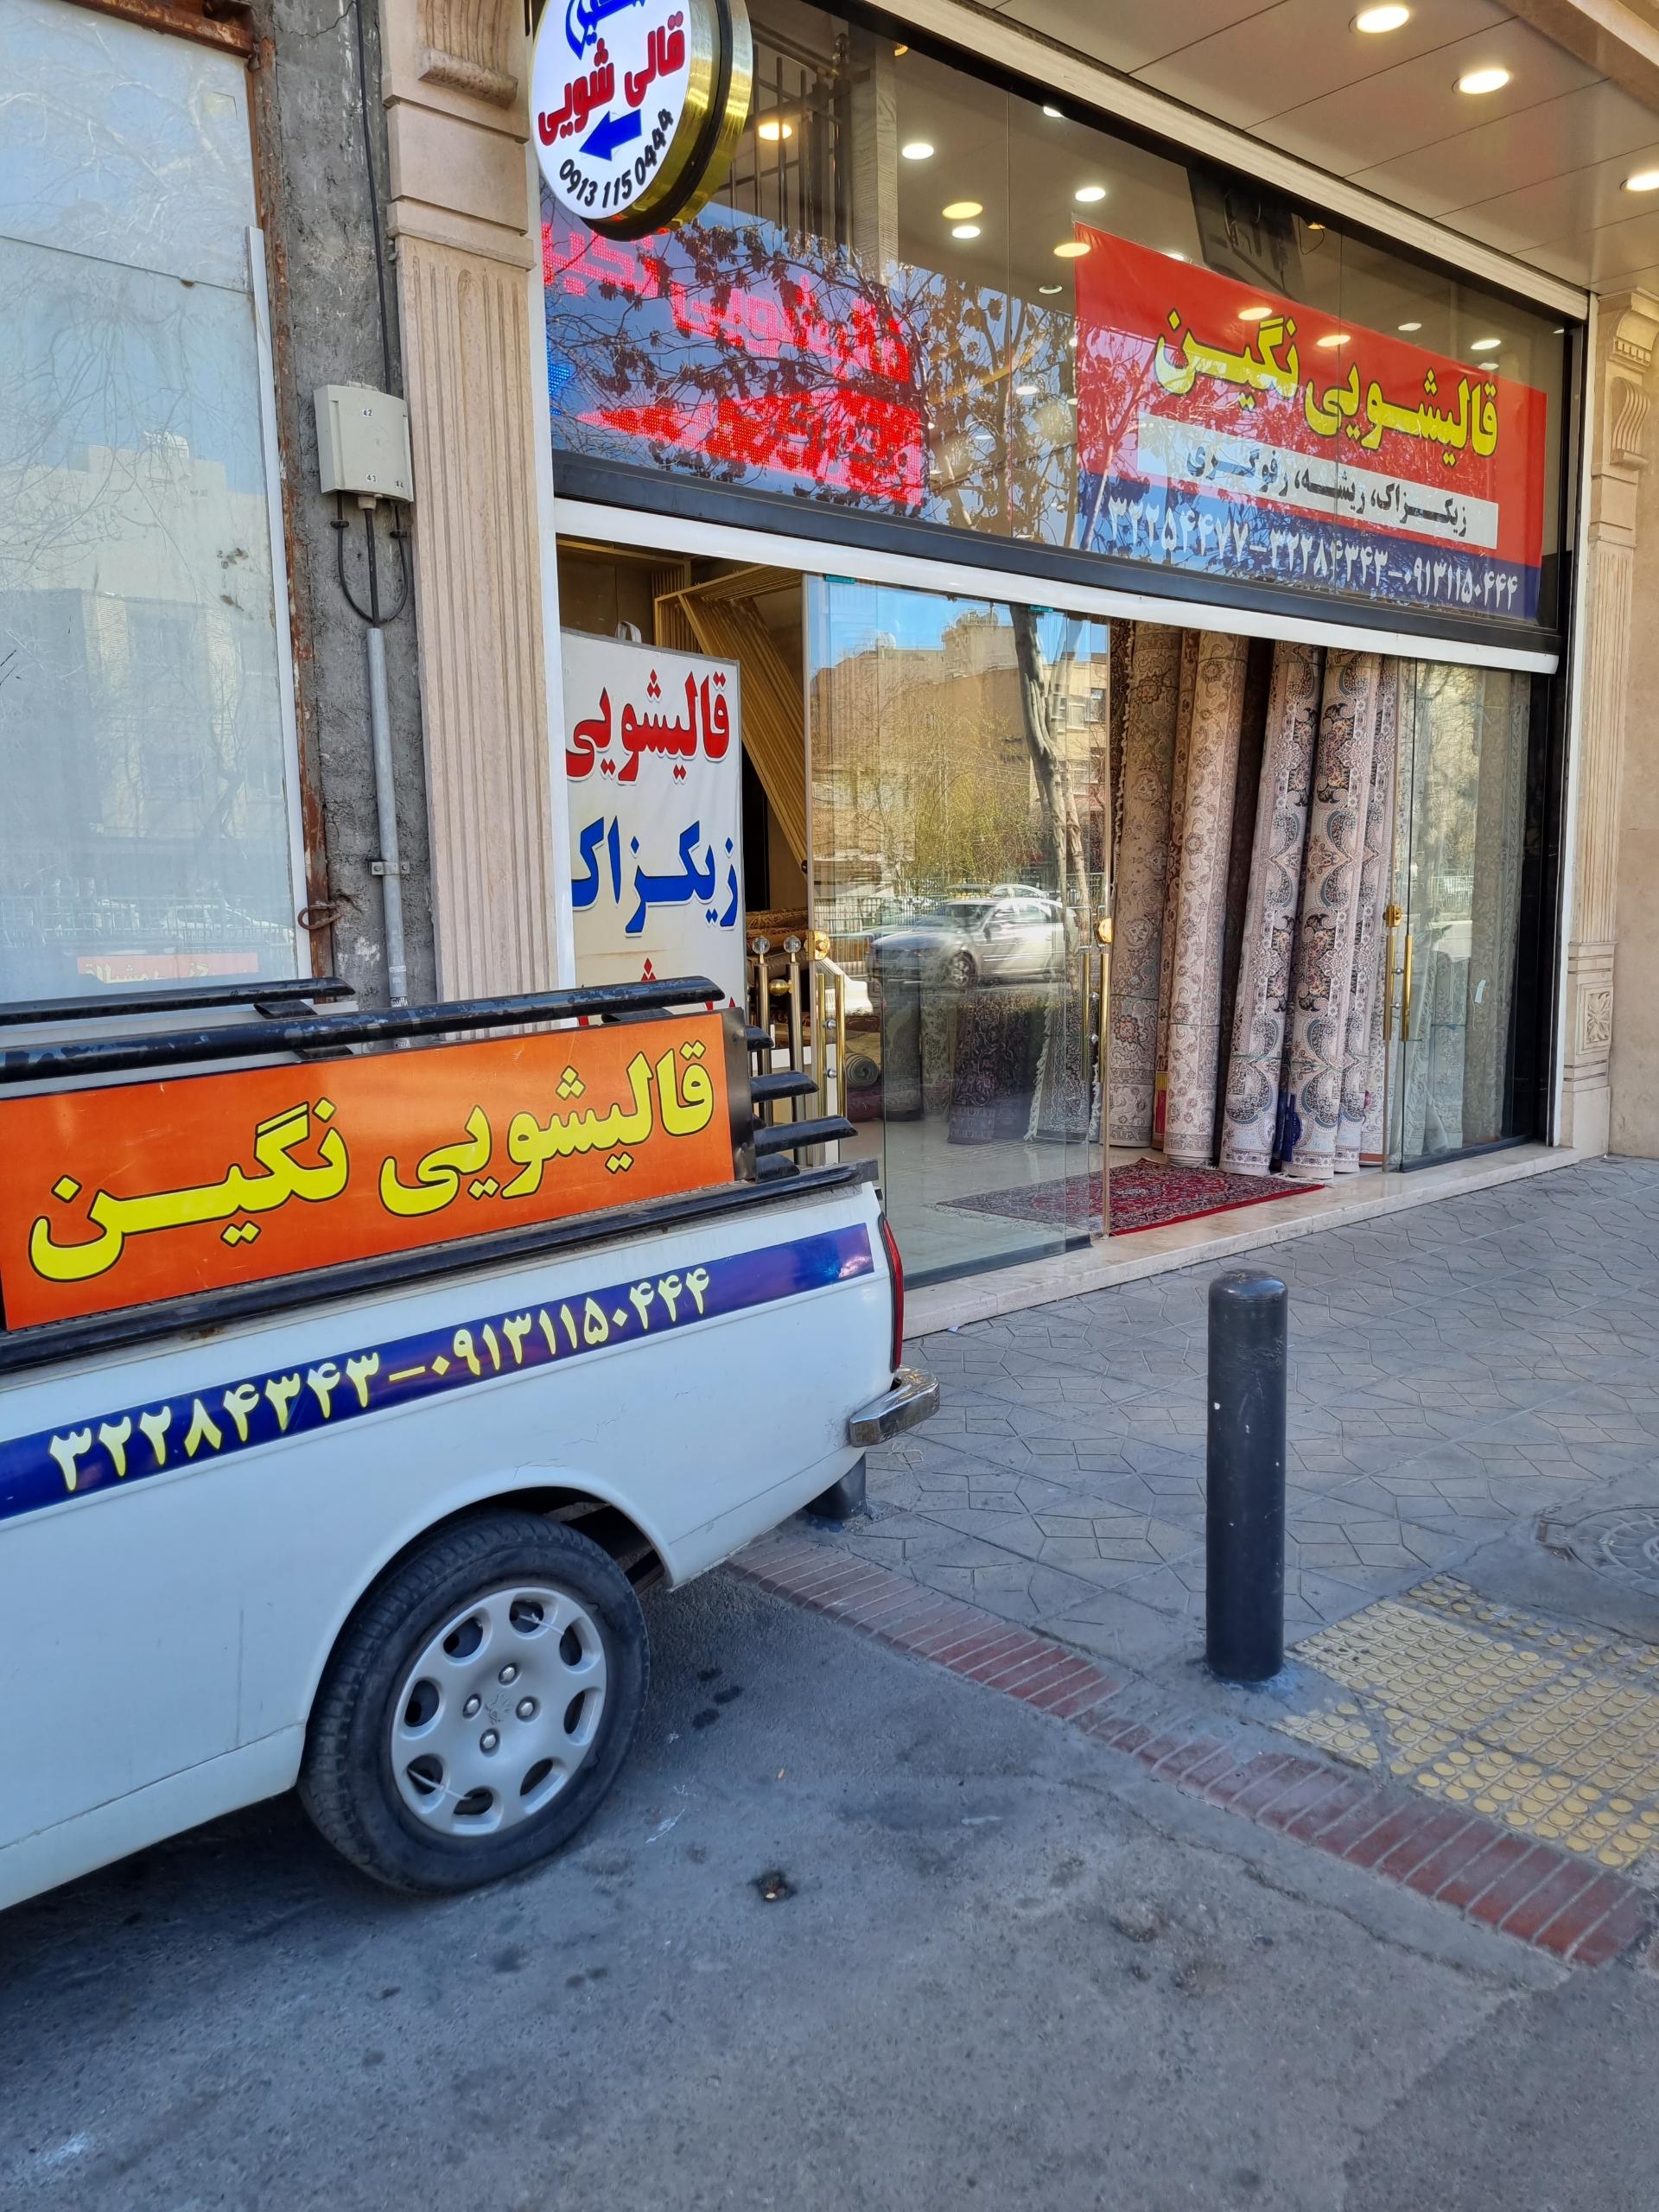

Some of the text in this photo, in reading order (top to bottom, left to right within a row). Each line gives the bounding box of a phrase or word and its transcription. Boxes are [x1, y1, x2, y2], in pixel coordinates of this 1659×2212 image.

[538, 38, 614, 146] شویی
[1154, 308, 1498, 467] قالیشویی نگین
[566, 669, 730, 781] قالیشویی
[29, 1040, 715, 1282] قالیشویی نگین
